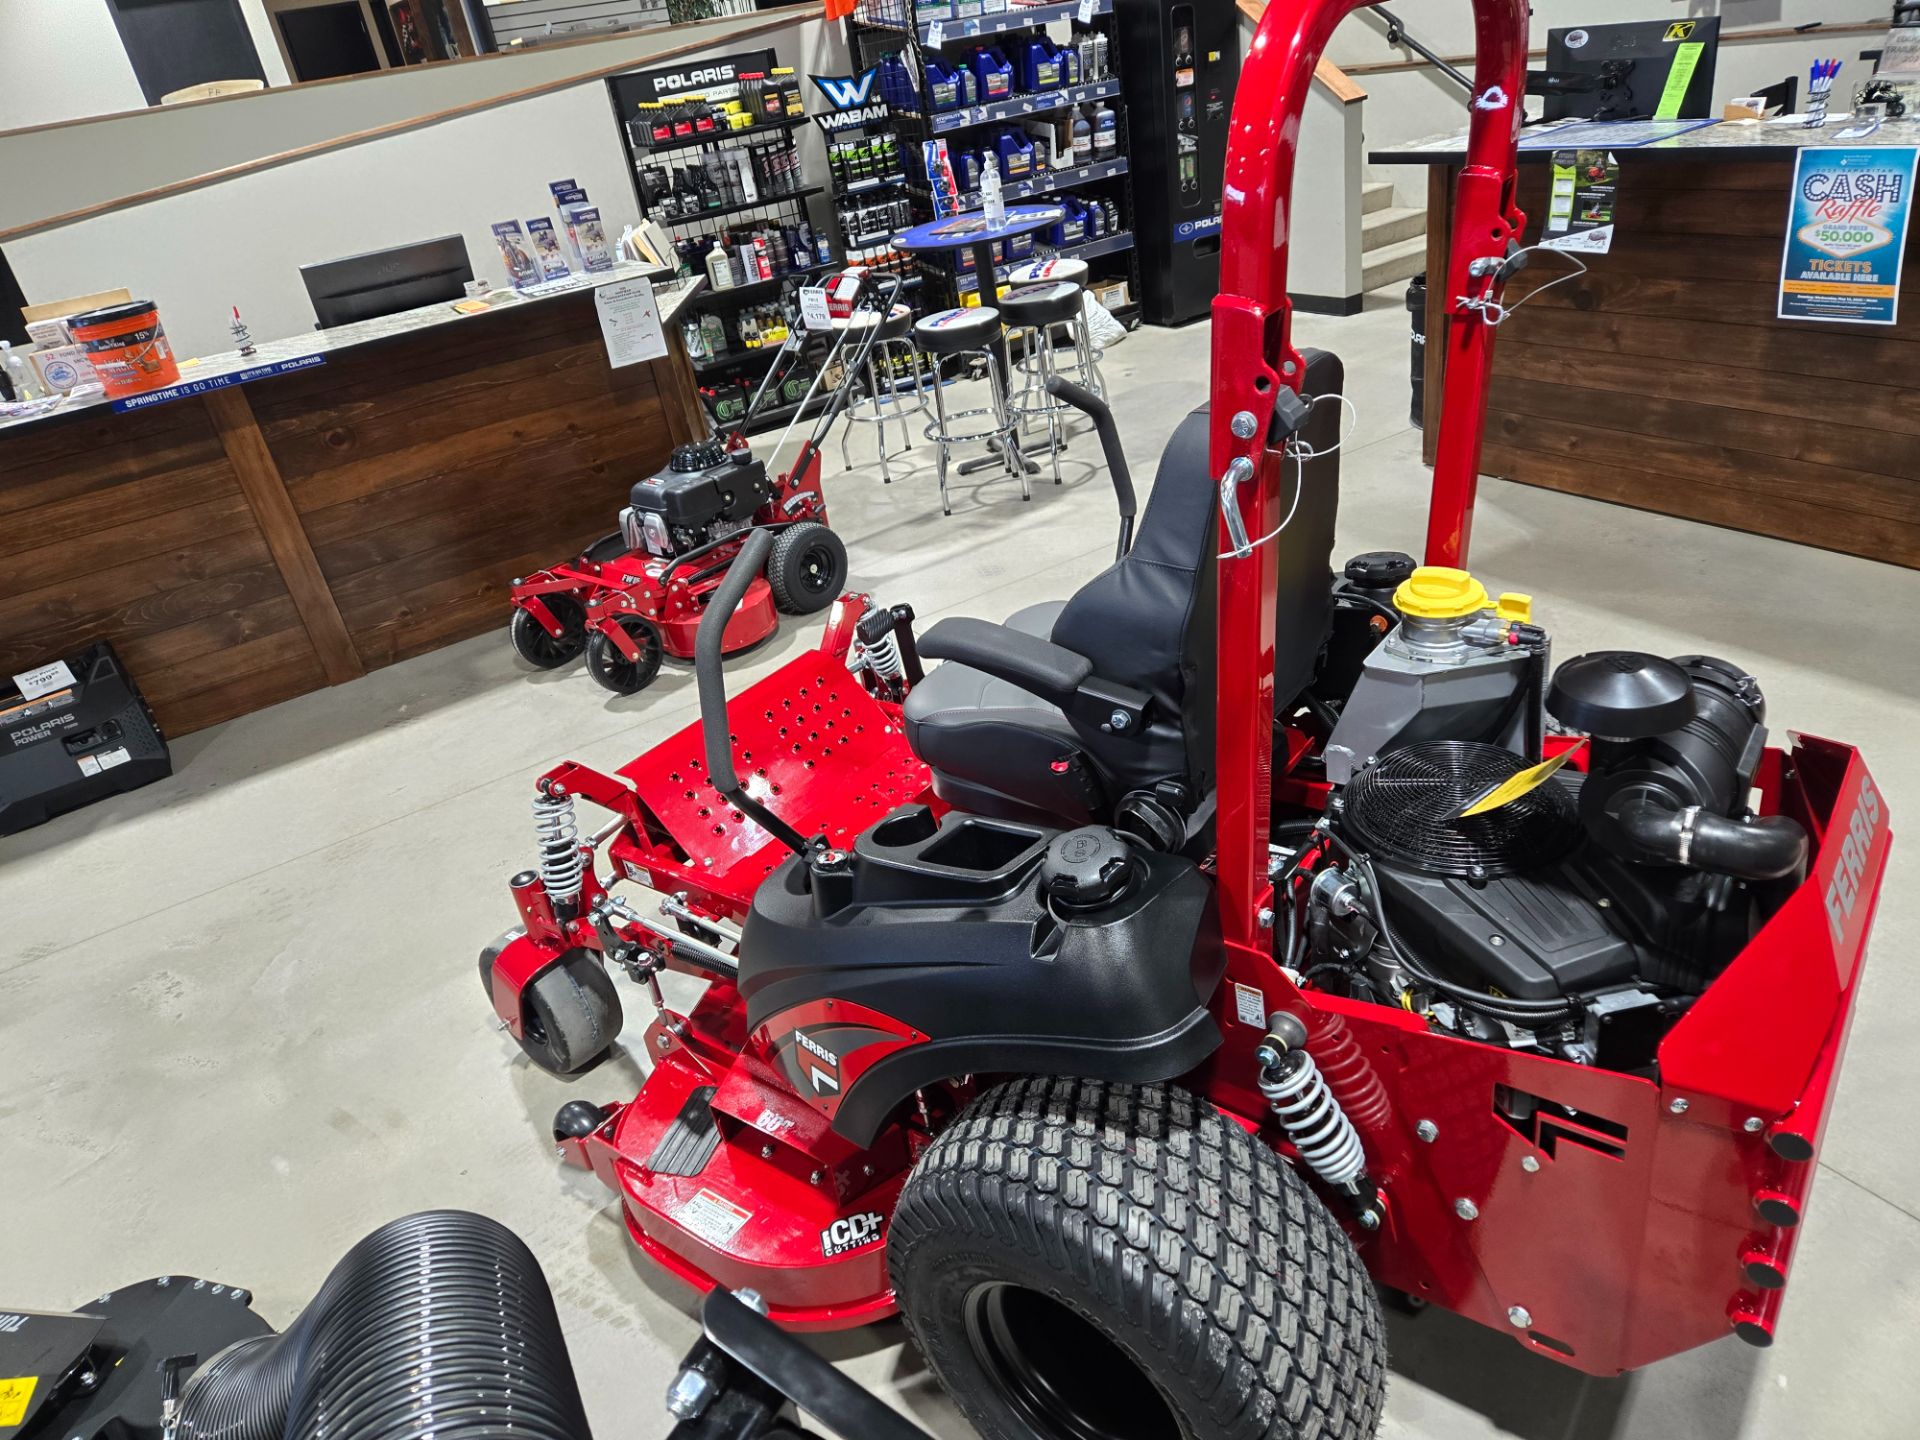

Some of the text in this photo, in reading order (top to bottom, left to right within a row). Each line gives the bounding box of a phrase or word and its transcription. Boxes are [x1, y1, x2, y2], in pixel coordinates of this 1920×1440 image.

[653, 65, 736, 92] POLARIS
[818, 104, 889, 129] WABAM
[1803, 174, 1903, 203] CASH
[1815, 198, 1882, 223] Raffle
[1815, 230, 1874, 243] $50,000
[1800, 271, 1879, 283] AVAILABLE HERE
[1809, 259, 1872, 273] TICKETS
[281, 356, 321, 370] POLARIS
[125, 376, 231, 408] SPRINGTIME IS GO TIME
[10, 713, 75, 740] POLARIS
[14, 730, 52, 747] POWER
[1825, 775, 1879, 945] FERRIS
[795, 1030, 838, 1067] FERRIS
[825, 1233, 880, 1256] CUTTING
